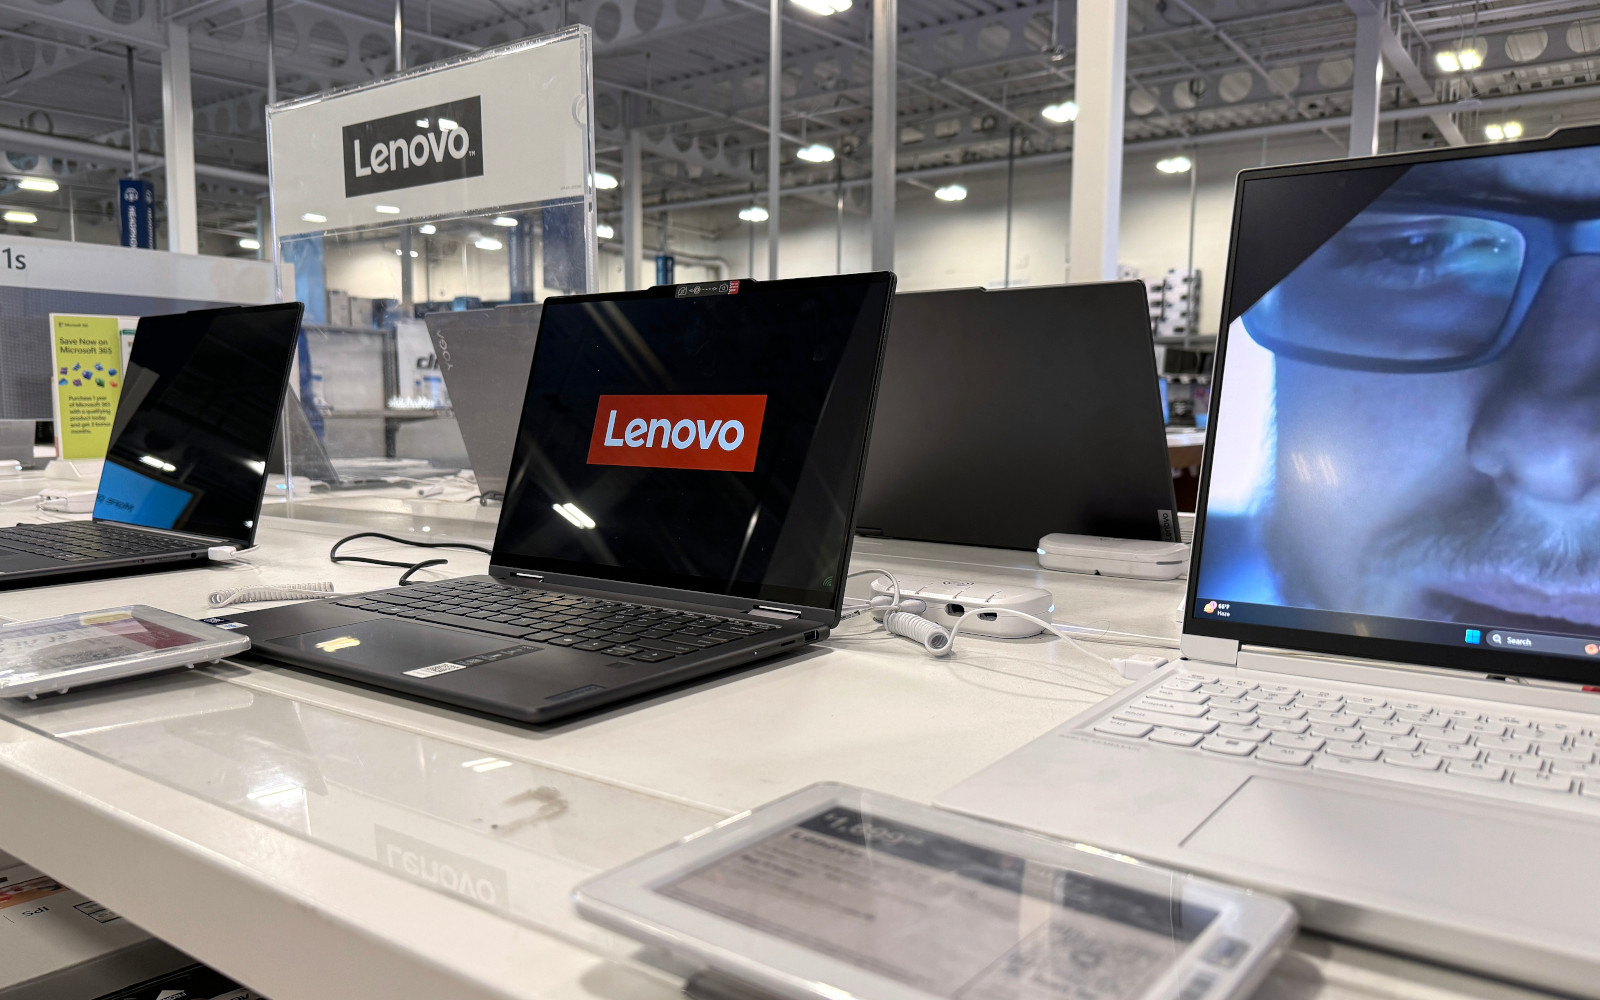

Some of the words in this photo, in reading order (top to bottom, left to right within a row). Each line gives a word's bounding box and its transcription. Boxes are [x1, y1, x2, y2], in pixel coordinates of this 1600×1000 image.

[354, 126, 469, 177] Lenovo
[604, 410, 745, 451] Lenovo
[1506, 636, 1532, 646] Search
